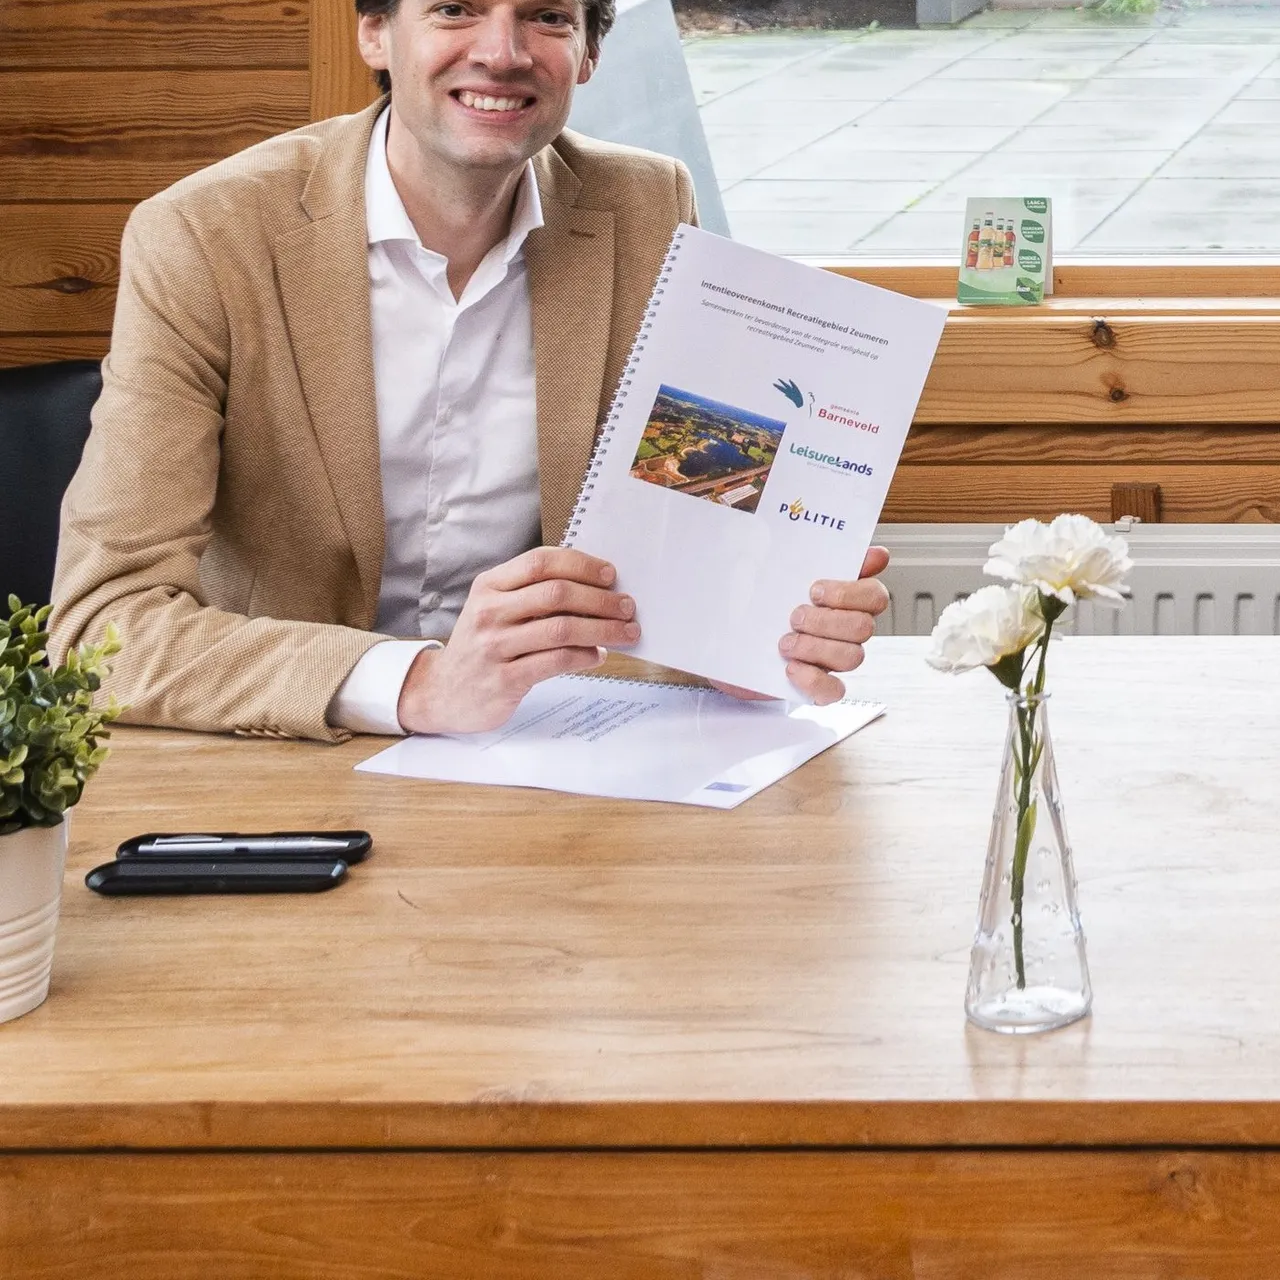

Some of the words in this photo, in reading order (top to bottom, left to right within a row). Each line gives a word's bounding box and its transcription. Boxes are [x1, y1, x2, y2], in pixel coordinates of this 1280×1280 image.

[701, 280, 785, 314] Intentieovereenkomst
[786, 308, 849, 334] Recreatiegebied
[849, 327, 889, 346] Zeumeren
[701, 299, 744, 318] Samenwerken
[745, 313, 754, 321] ter
[754, 316, 791, 334] bevordering
[791, 327, 803, 337] van
[804, 331, 812, 339] de
[812, 335, 840, 348] integrale
[840, 342, 870, 358] veiligheid
[870, 350, 879, 361] op
[746, 324, 794, 344] recreatiegebied
[794, 340, 825, 354] Zeumeren
[818, 408, 880, 434] Barneveld
[790, 442, 873, 476] LeisureLands
[780, 499, 846, 530] POLITIE
